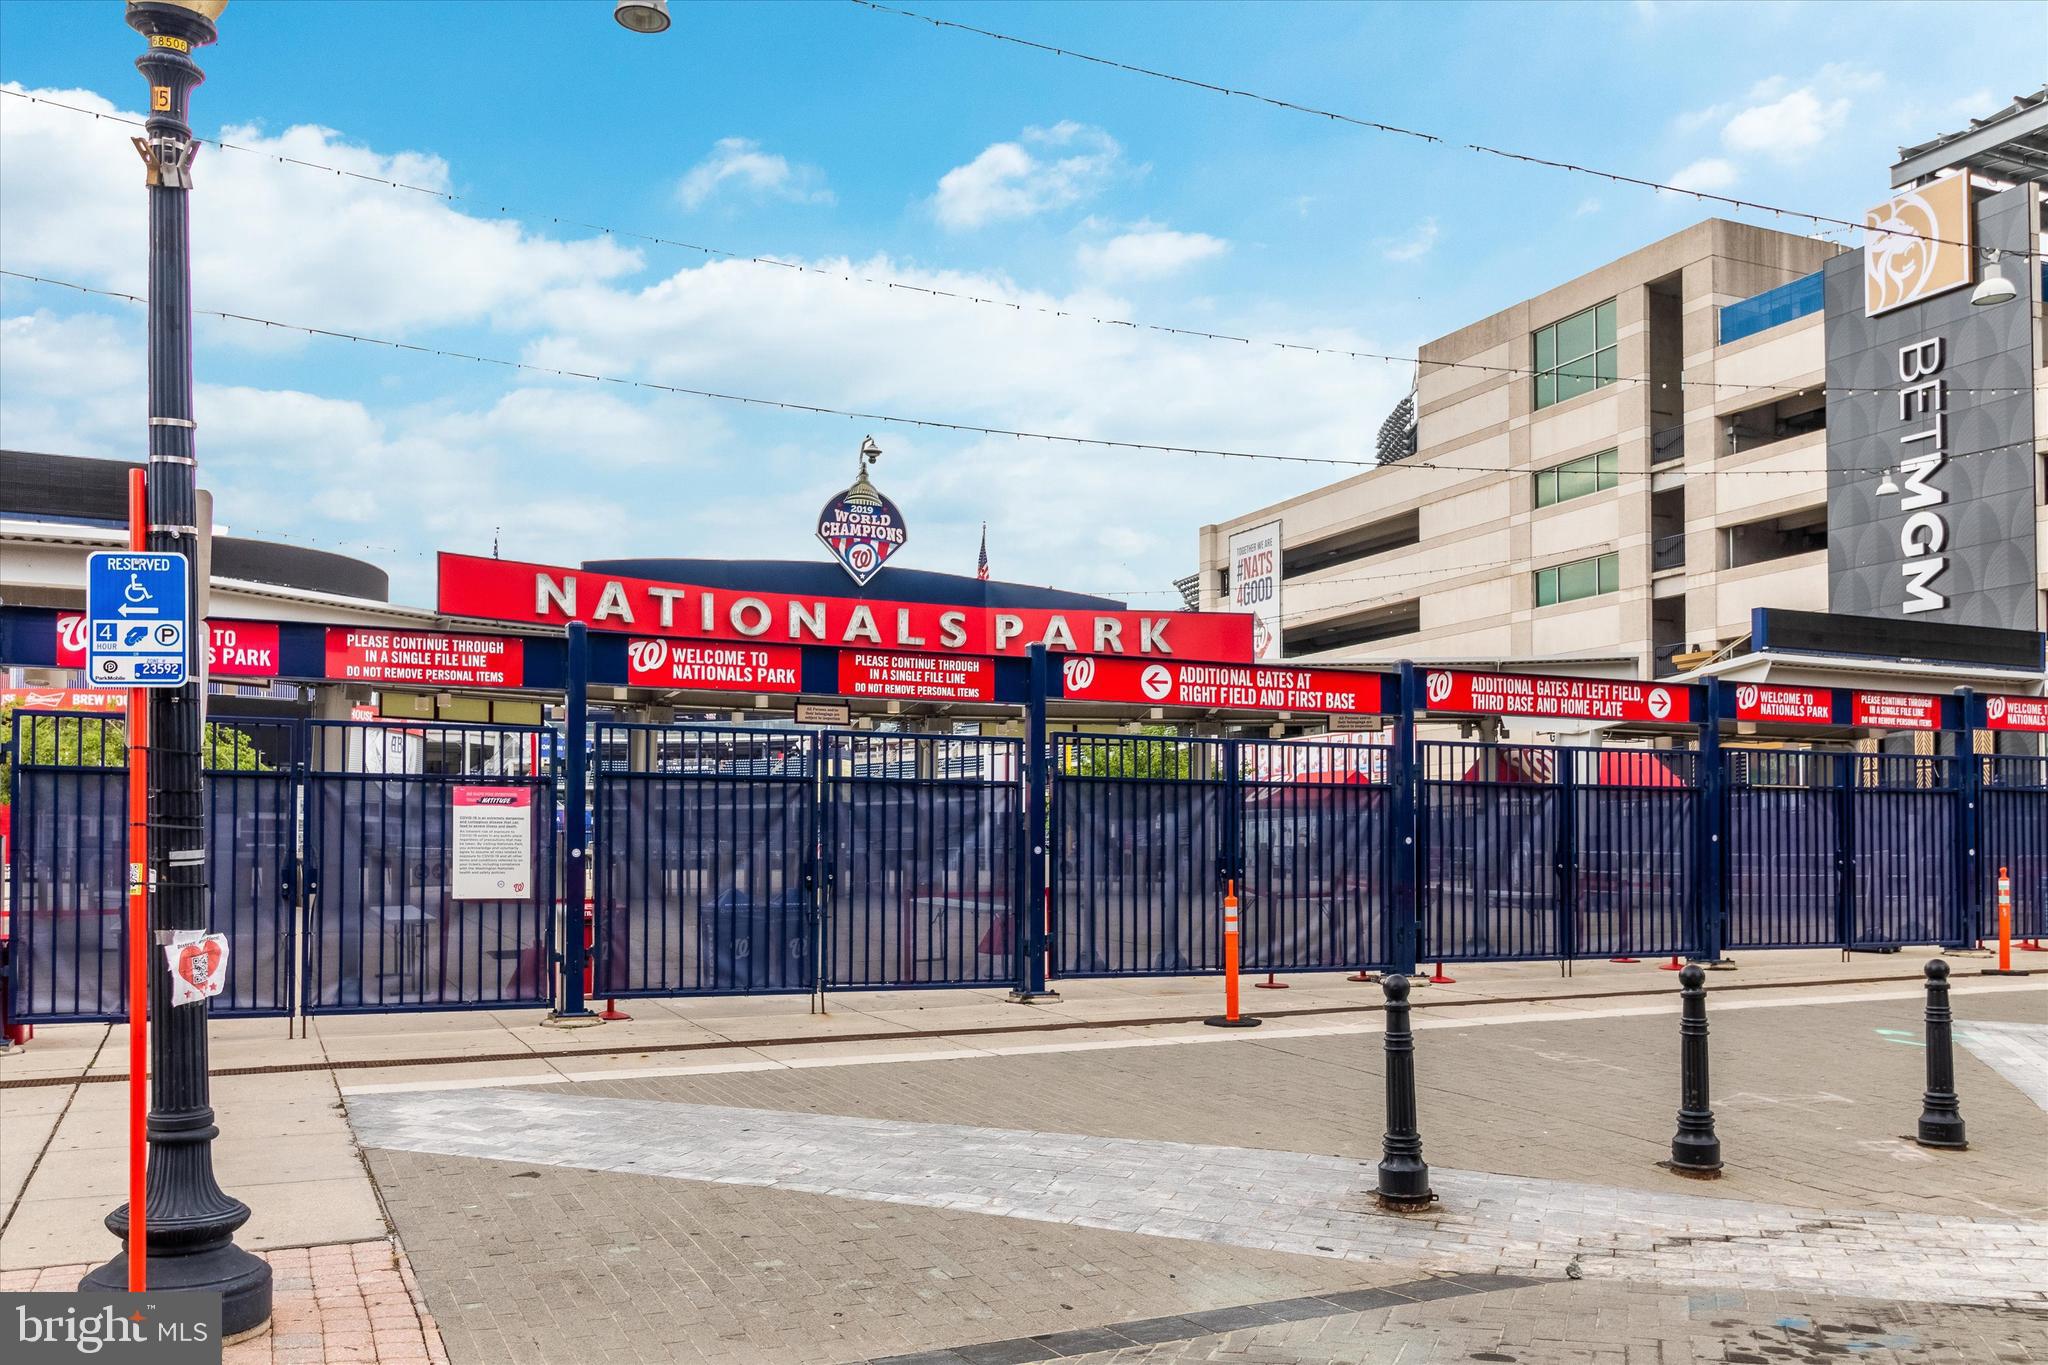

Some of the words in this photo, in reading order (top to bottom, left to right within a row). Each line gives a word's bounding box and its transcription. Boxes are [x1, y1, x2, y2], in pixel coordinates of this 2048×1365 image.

[1899, 337, 1944, 615] BETMGM
[834, 509, 891, 526] WORLD
[851, 504, 874, 514] 2019
[821, 522, 904, 544] CHAMPIONS
[1236, 543, 1256, 556] TOGETHER
[1258, 540, 1264, 551] WE
[108, 558, 170, 571] RESERVED
[1237, 550, 1272, 583] #NATS
[1236, 576, 1272, 607] 4GOOD
[535, 573, 968, 649] NATIONALS
[995, 613, 1174, 654] PARK
[100, 624, 112, 640] 4
[214, 629, 236, 646] TO
[347, 634, 389, 648] PLEASE
[393, 637, 448, 651] CONTINUE
[452, 640, 503, 654] THROUGH
[223, 649, 271, 667] PARK
[365, 649, 377, 662] IN
[380, 650, 388, 662] A
[392, 651, 431, 664] SINGLE
[435, 653, 458, 666] FILE
[462, 654, 486, 667] LINE
[672, 648, 746, 665] WELCOME
[750, 652, 768, 666] TO
[856, 655, 888, 667] PLEASE
[892, 657, 936, 670] CONTINUE
[938, 660, 979, 672] THROUGH
[142, 664, 178, 674] 23592
[346, 665, 360, 676] DO
[363, 666, 382, 677] NOT
[384, 667, 422, 679] REMOVE
[426, 669, 474, 682] PERSONAL
[476, 672, 503, 682] ITEMS
[673, 664, 752, 682] NATIONALS
[758, 668, 795, 683] PARK
[870, 669, 879, 679] IN
[882, 670, 888, 680] A
[890, 670, 922, 682] SINGLE
[925, 672, 943, 682] FILE
[946, 673, 965, 684] LINE
[1180, 666, 1253, 686] ADDITIONAL
[1257, 671, 1294, 688] GATES
[1297, 673, 1311, 689] AT
[856, 683, 866, 692] DO
[868, 684, 883, 692] NOT
[885, 684, 915, 694] REMOVE
[918, 686, 955, 696] PERSONAL
[958, 688, 979, 697] ITEMS
[1180, 685, 1217, 703] RIGHT
[1221, 687, 1256, 704] FIELD
[1260, 689, 1284, 706] AND
[1288, 691, 1322, 708] FIRST
[1326, 692, 1355, 709] BASE
[1472, 677, 1534, 694] ADDITIONAL
[1537, 681, 1568, 696] GATES
[1572, 683, 1583, 698] AT
[1587, 684, 1610, 699] LEFT
[1613, 686, 1643, 703] FIELD,
[1760, 692, 1800, 704] WELCOME
[1803, 694, 1813, 705] TO
[72, 694, 104, 704] BREW
[1472, 694, 1504, 710] THIRD
[1508, 696, 1534, 712] BASE
[1537, 698, 1557, 713] AND
[1561, 699, 1590, 714] HOME
[1593, 700, 1622, 716] PLATE
[1862, 695, 1880, 704] PLEASE
[1882, 696, 1907, 706] CONTINUE
[1908, 698, 1932, 707] THROUGH
[1761, 704, 1804, 716] NATIONALS
[1807, 706, 1828, 718] PARK
[1870, 706, 1875, 714] IN
[1876, 706, 1880, 714] A
[1881, 706, 1899, 715] SINGLE
[1900, 707, 1912, 716] FILE
[1912, 708, 1924, 716] LINE
[2007, 702, 2042, 714] WELCOME
[2043, 704, 2048, 715] T
[1878, 718, 1896, 726] REMOVE
[1898, 718, 1917, 726] PERSONAL
[2008, 714, 2046, 726] NATIONALS
